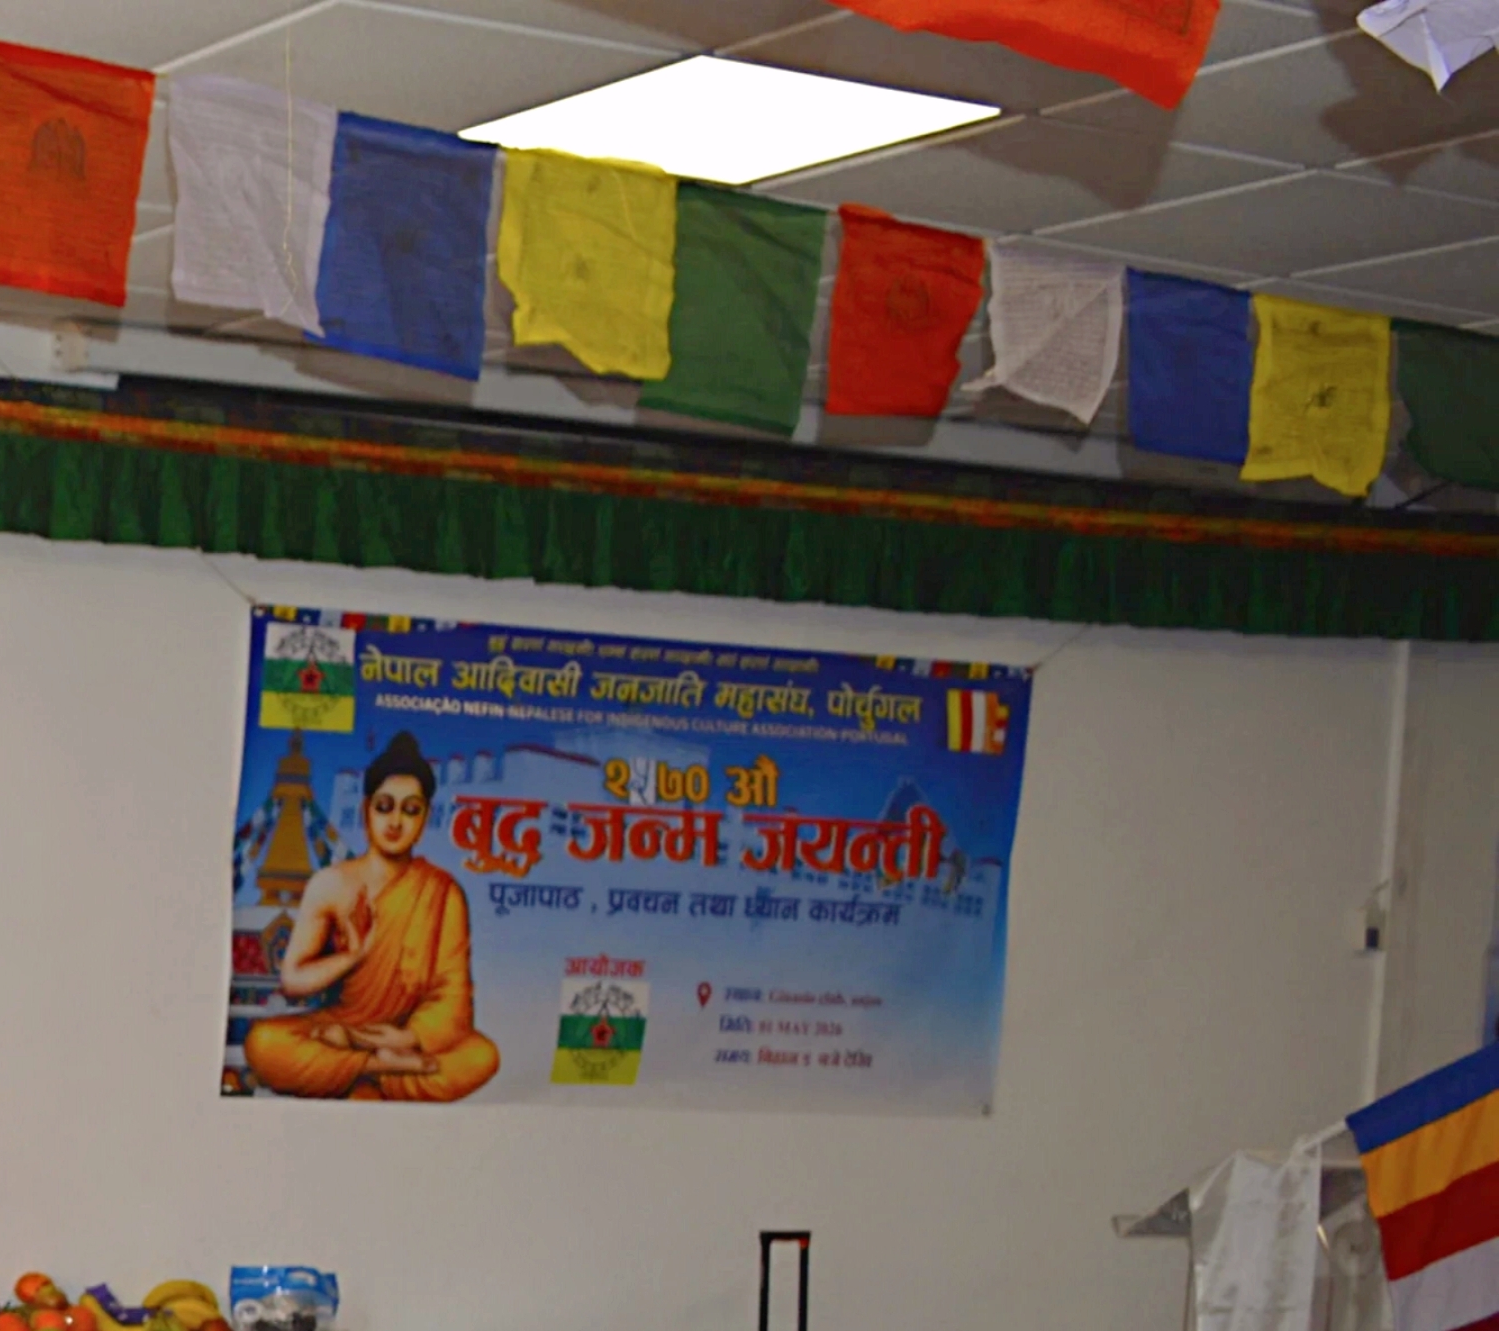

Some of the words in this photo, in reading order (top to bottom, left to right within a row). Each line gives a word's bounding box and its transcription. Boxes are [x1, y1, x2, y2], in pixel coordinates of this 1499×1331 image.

[358, 643, 443, 689] नेपाल
[451, 655, 582, 698] आदिवासी
[590, 669, 707, 708] जनजाति
[375, 693, 461, 716] ASSOCIAÇÃO
[566, 803, 723, 867] जन्म
[689, 891, 736, 917] तथा
